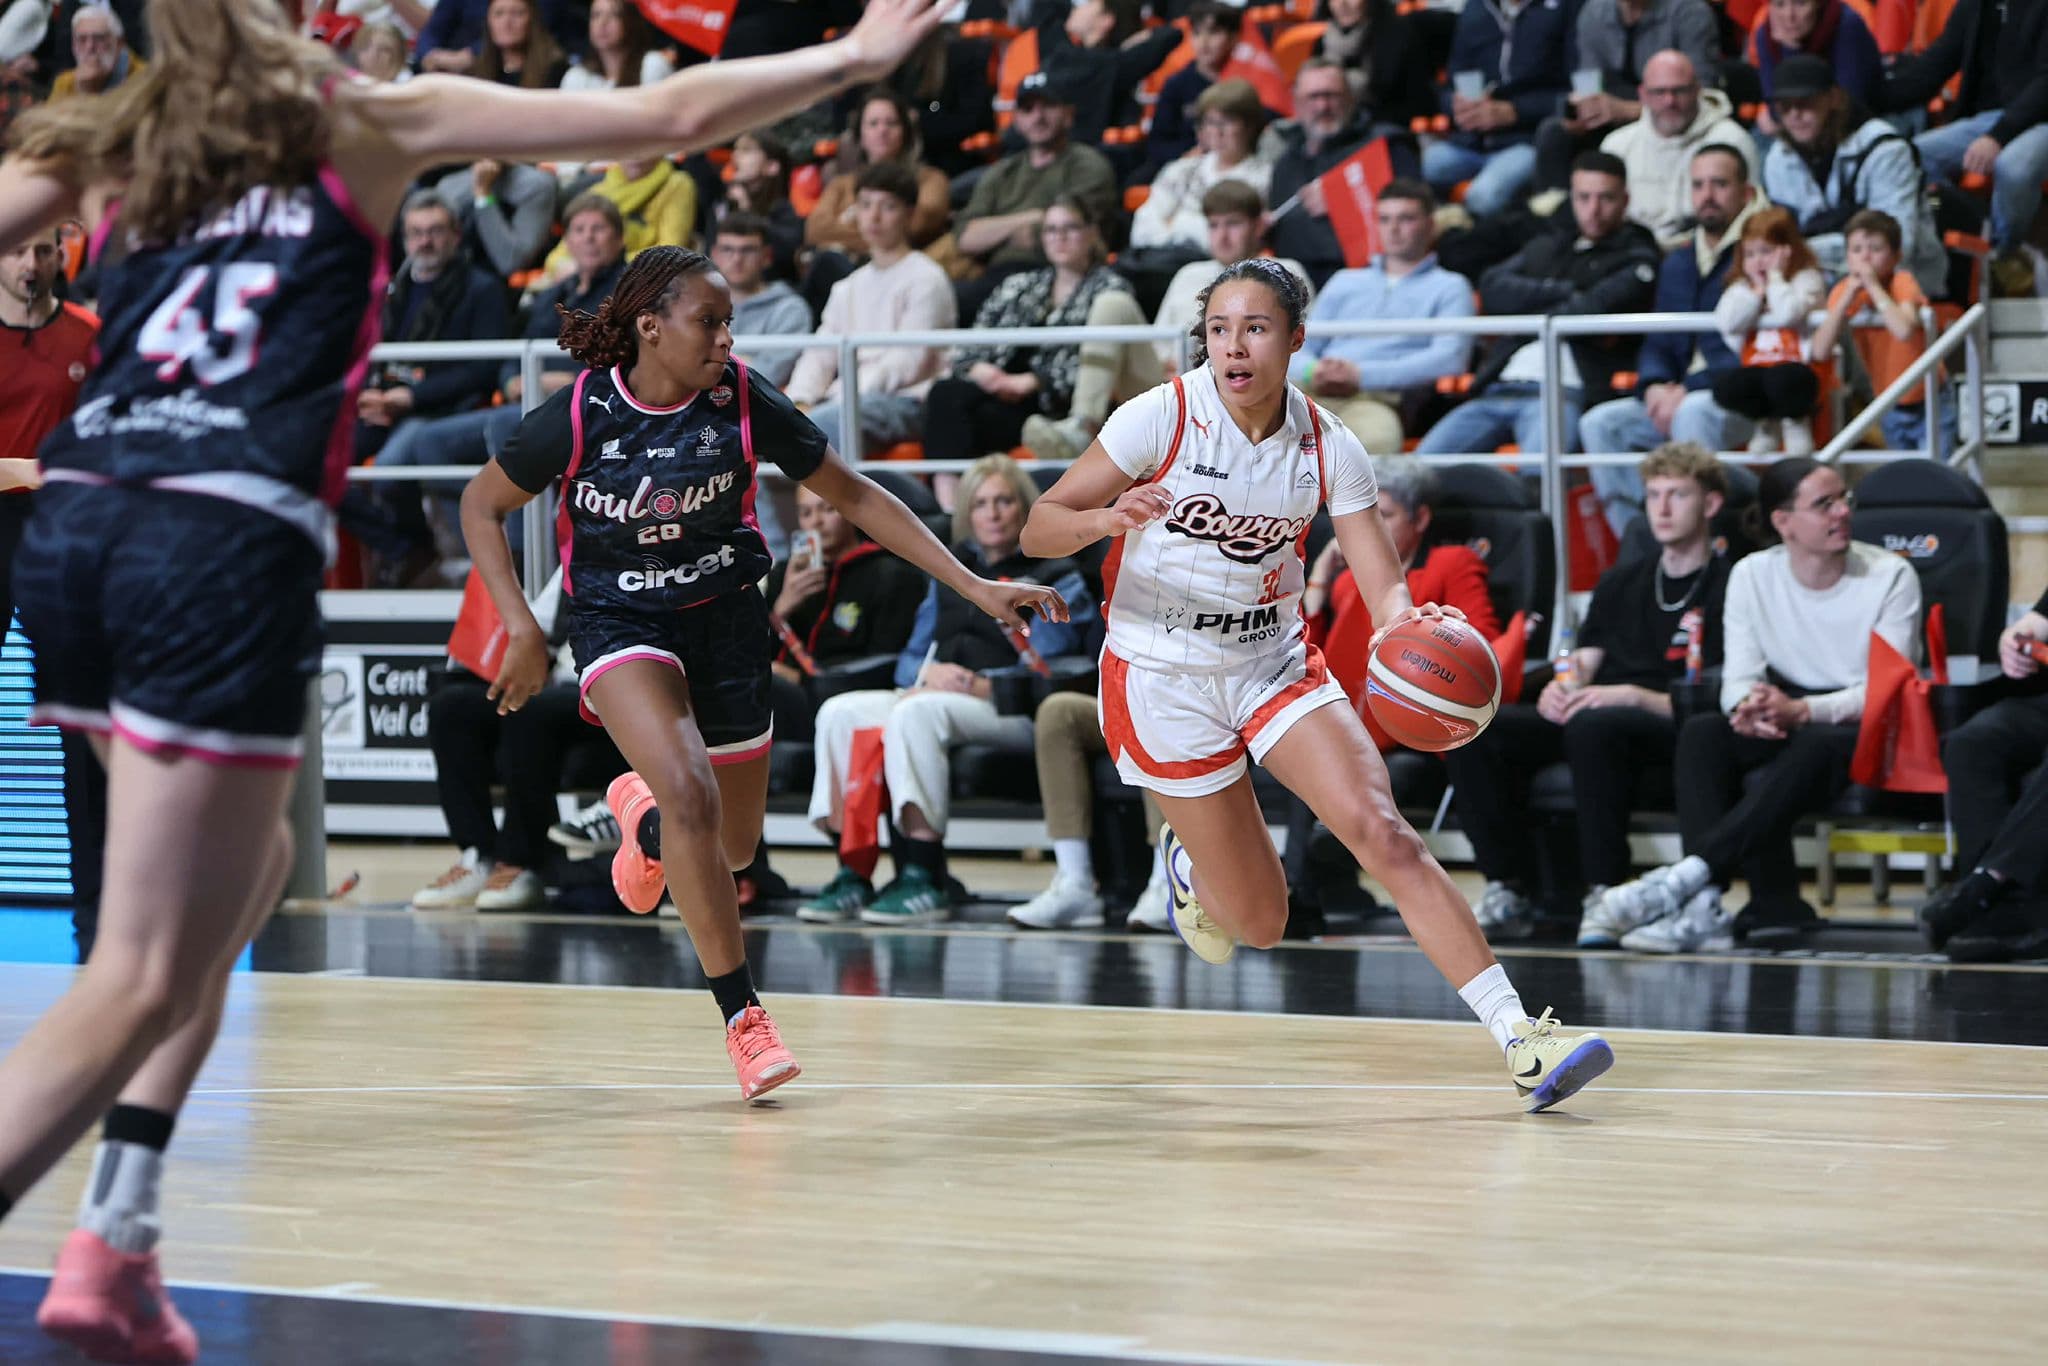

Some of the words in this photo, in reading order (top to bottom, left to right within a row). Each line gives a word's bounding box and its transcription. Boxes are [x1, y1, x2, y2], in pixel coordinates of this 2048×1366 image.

[137, 261, 277, 385] 45
[2031, 397, 2048, 425] R
[617, 545, 735, 592] circet
[1193, 604, 1278, 634] PHM
[367, 662, 428, 696] Cent
[1401, 648, 1457, 684] molten
[368, 701, 409, 737] Val
